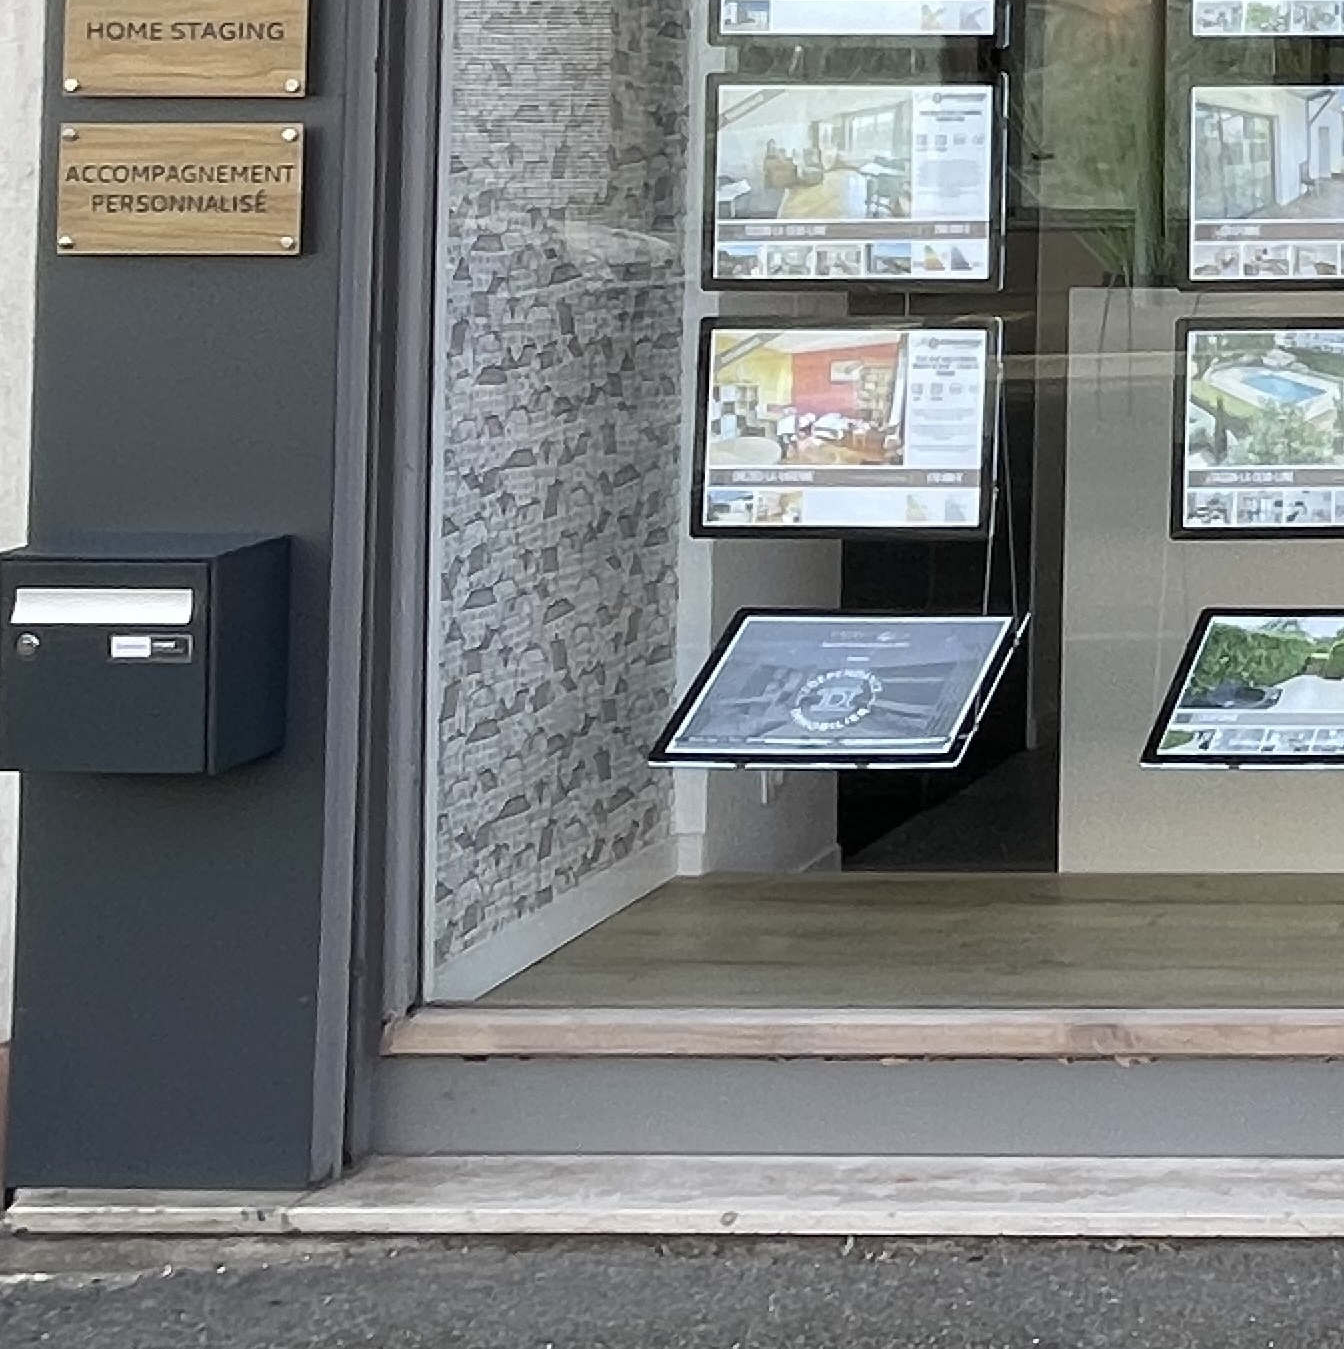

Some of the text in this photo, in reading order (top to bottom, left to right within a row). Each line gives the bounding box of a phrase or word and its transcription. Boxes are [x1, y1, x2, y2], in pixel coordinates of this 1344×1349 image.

[86, 22, 285, 41] HOME STAGING
[65, 164, 296, 184] ACCOMPAGNEMENT
[91, 189, 268, 213] PERSONNALISÉ
